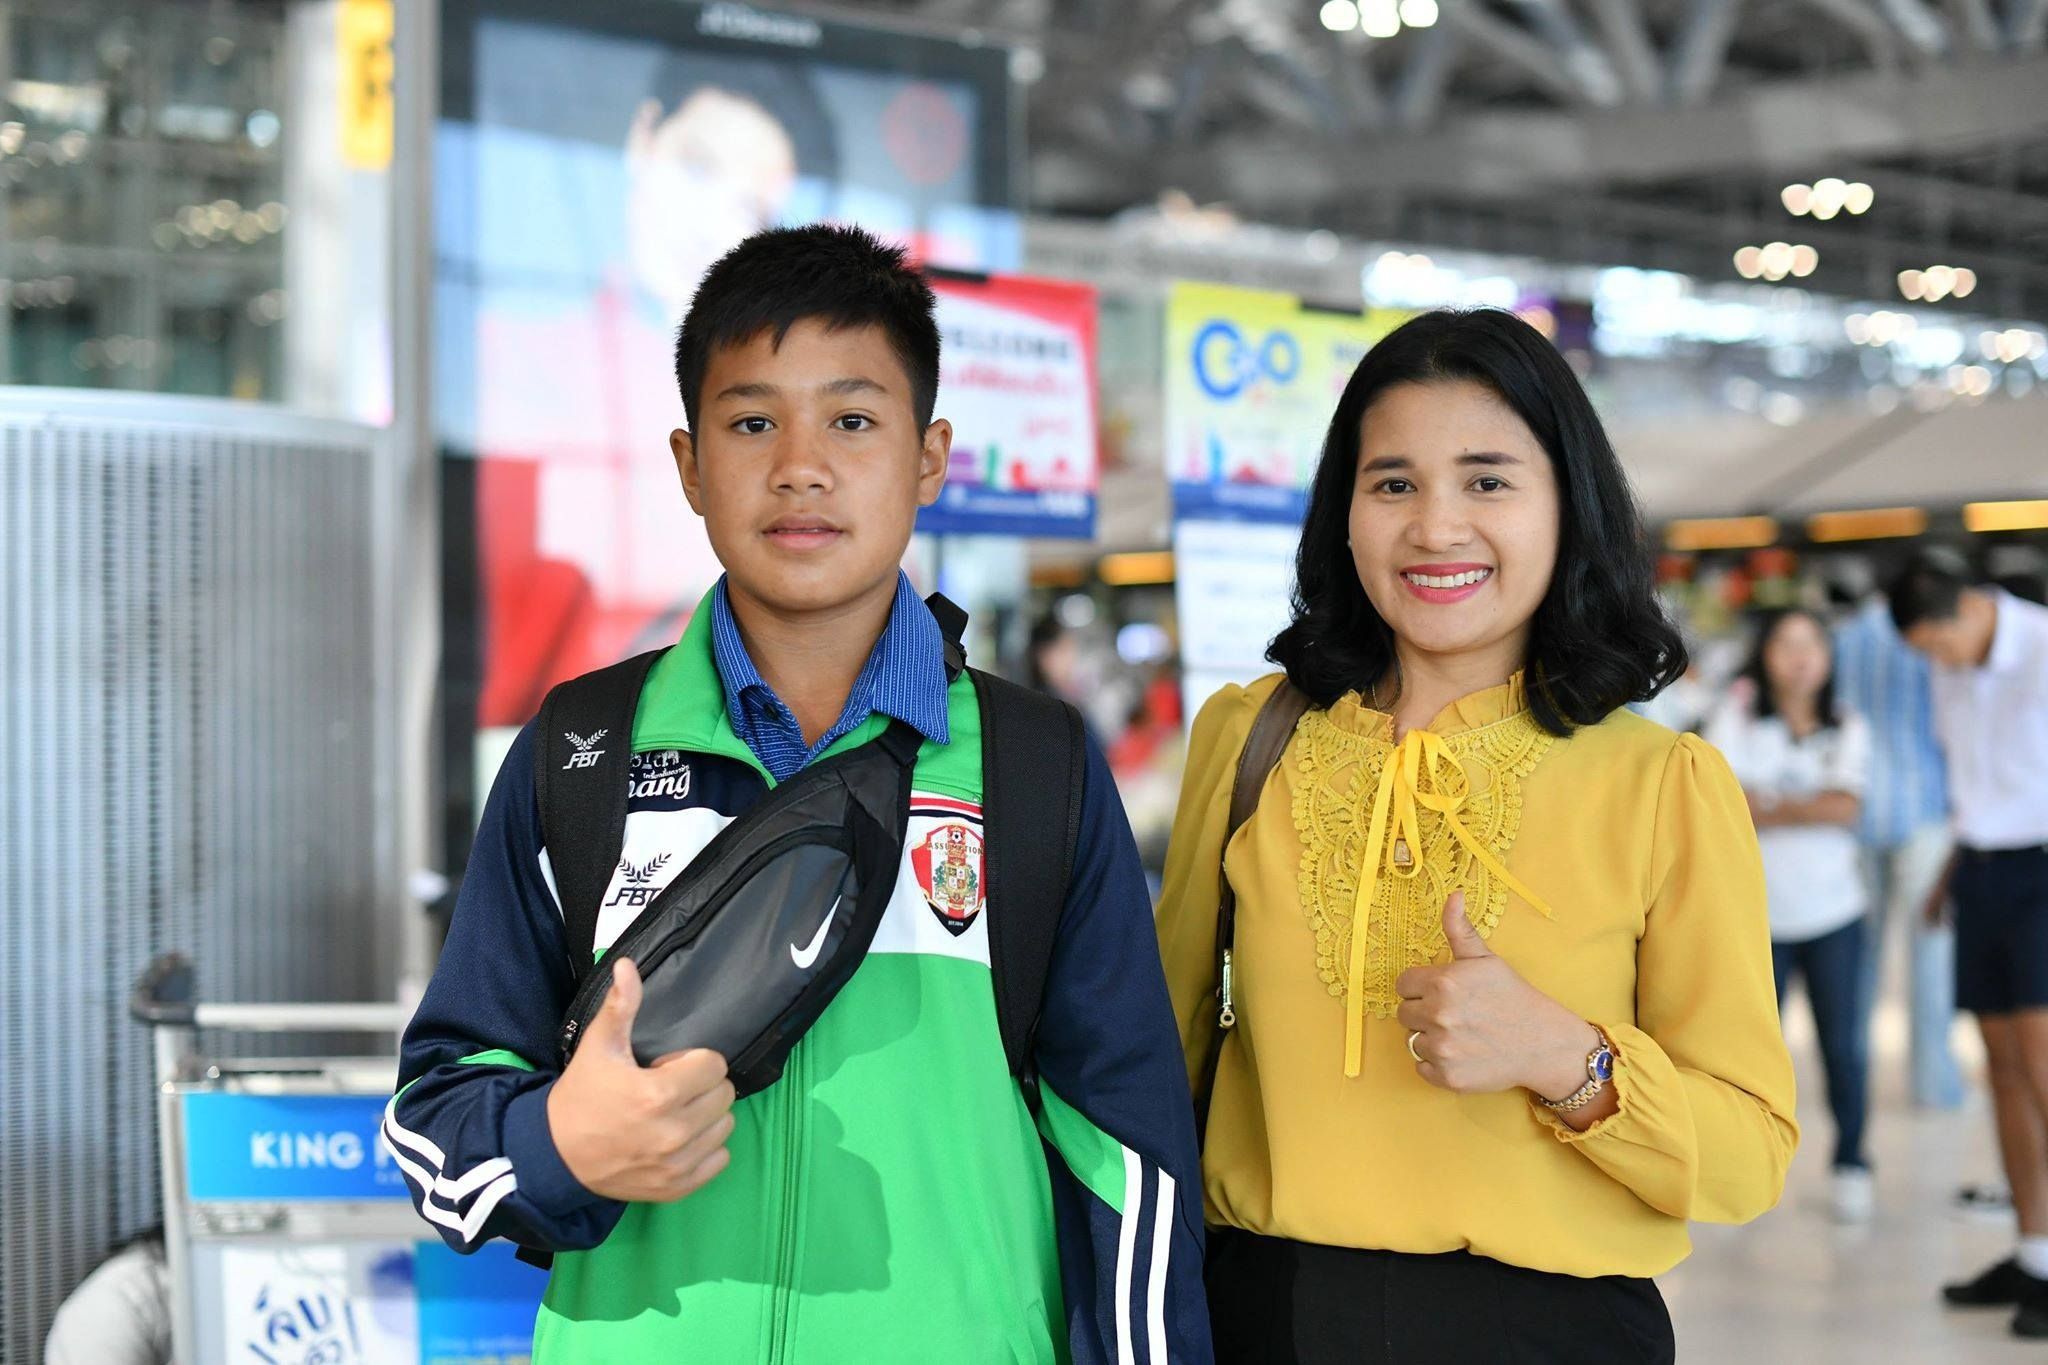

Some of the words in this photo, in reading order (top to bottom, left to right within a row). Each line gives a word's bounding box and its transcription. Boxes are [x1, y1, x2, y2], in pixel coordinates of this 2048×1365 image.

[562, 750, 606, 770] FBT
[605, 886, 663, 907] FBT
[251, 1130, 364, 1169] KING
